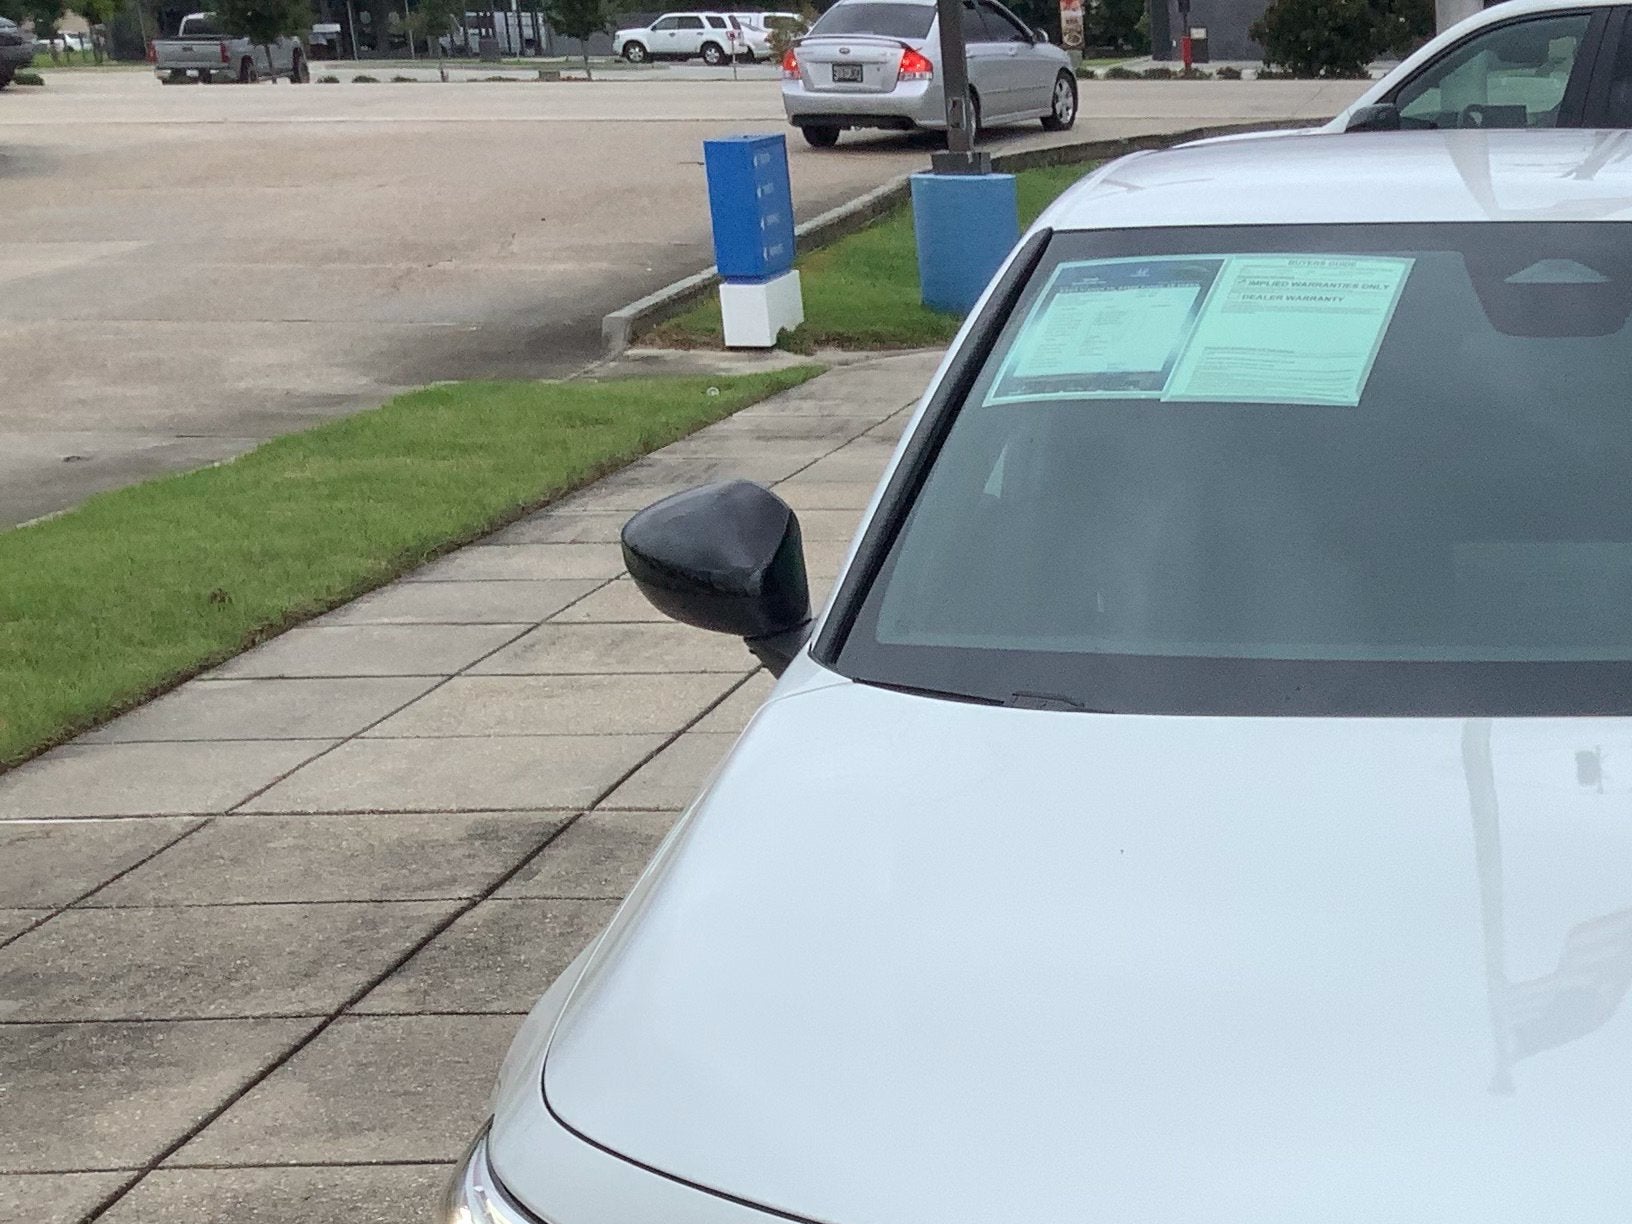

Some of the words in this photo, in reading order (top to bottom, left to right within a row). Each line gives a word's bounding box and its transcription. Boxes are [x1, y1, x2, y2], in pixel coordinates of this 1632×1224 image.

[1248, 280, 1290, 288] IMPLIED
[1291, 281, 1359, 289] WARRANTIES
[1242, 293, 1284, 301] DEALER
[1285, 294, 1345, 302] WARRANTY
